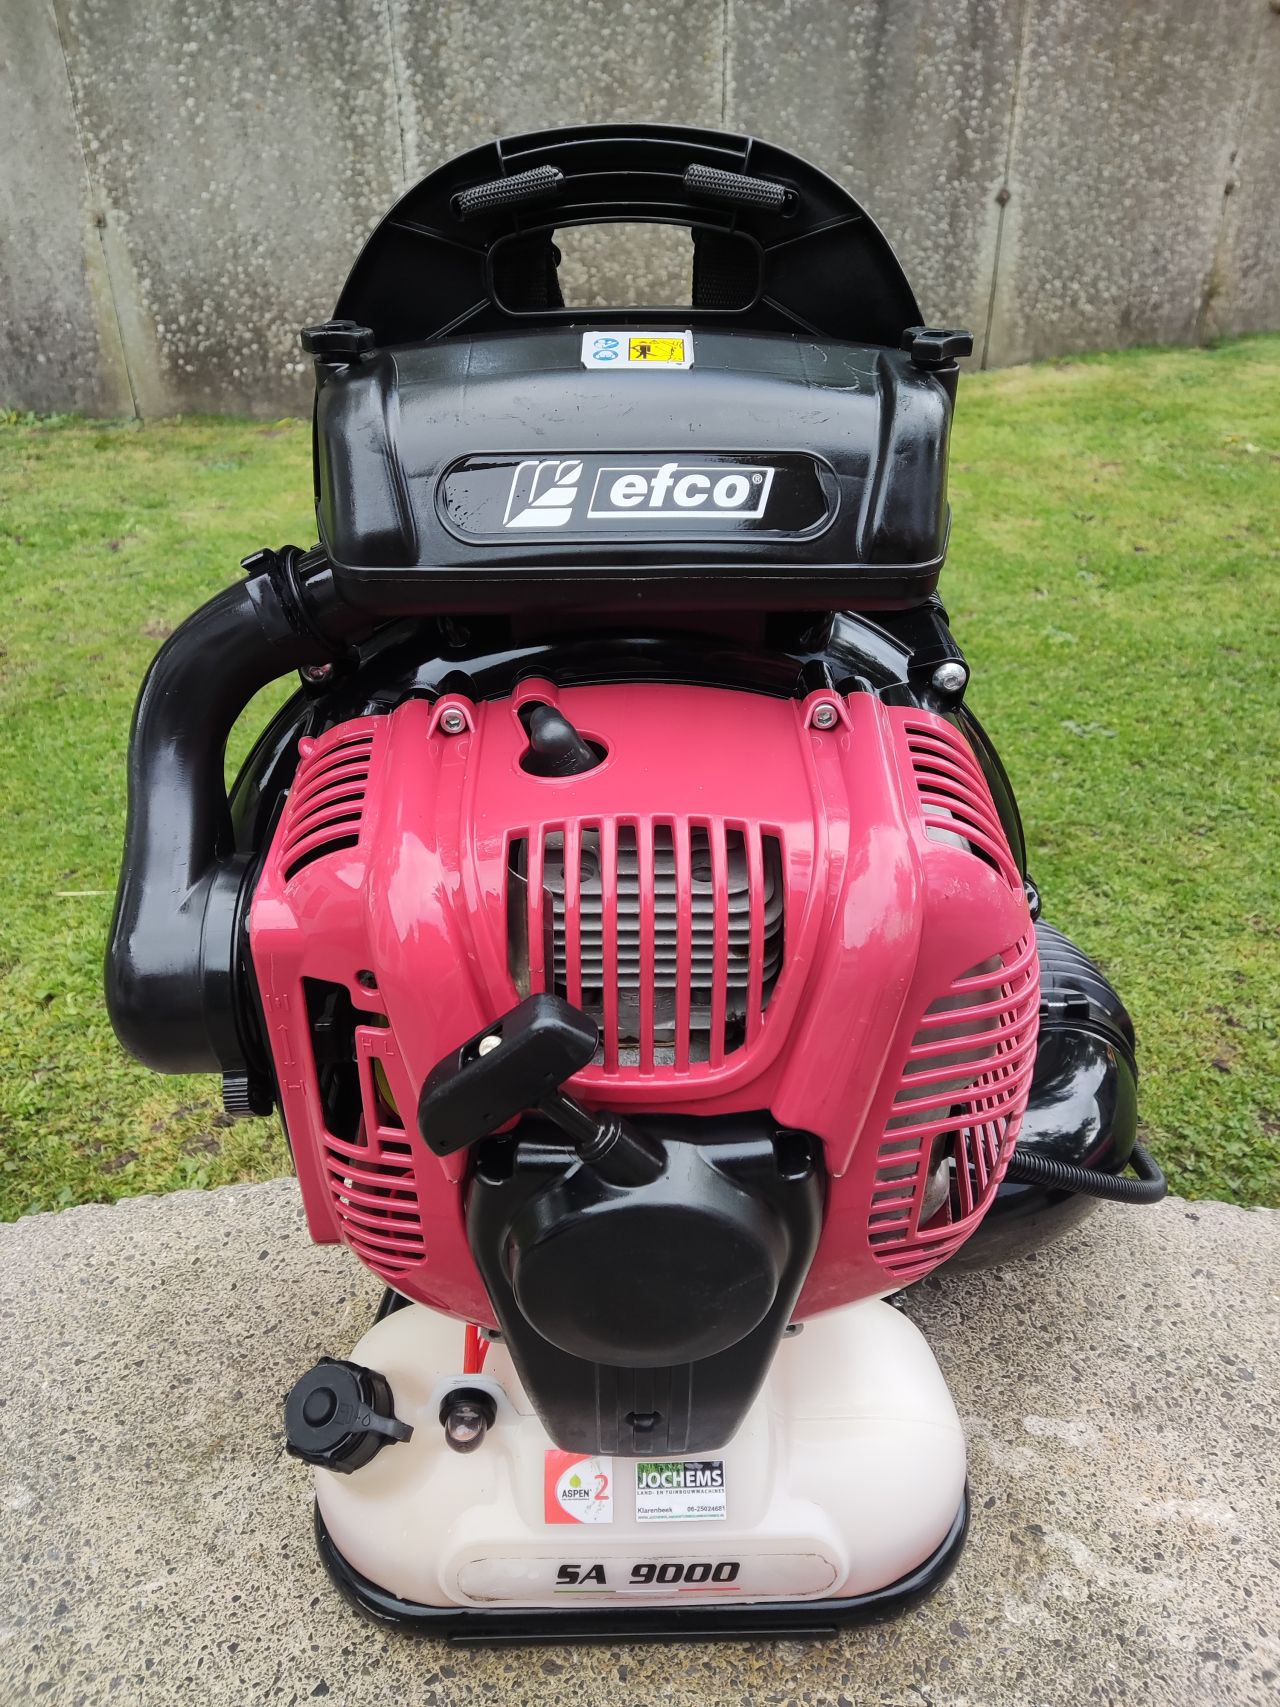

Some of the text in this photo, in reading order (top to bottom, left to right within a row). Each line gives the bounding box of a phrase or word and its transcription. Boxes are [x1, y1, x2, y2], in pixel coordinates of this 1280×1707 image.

[561, 1473, 610, 1501] ASPEN 2
[638, 1469, 723, 1489] JOCHEMS
[637, 1506, 673, 1514] Klarenbeek
[555, 1561, 741, 1585] SA 9000
